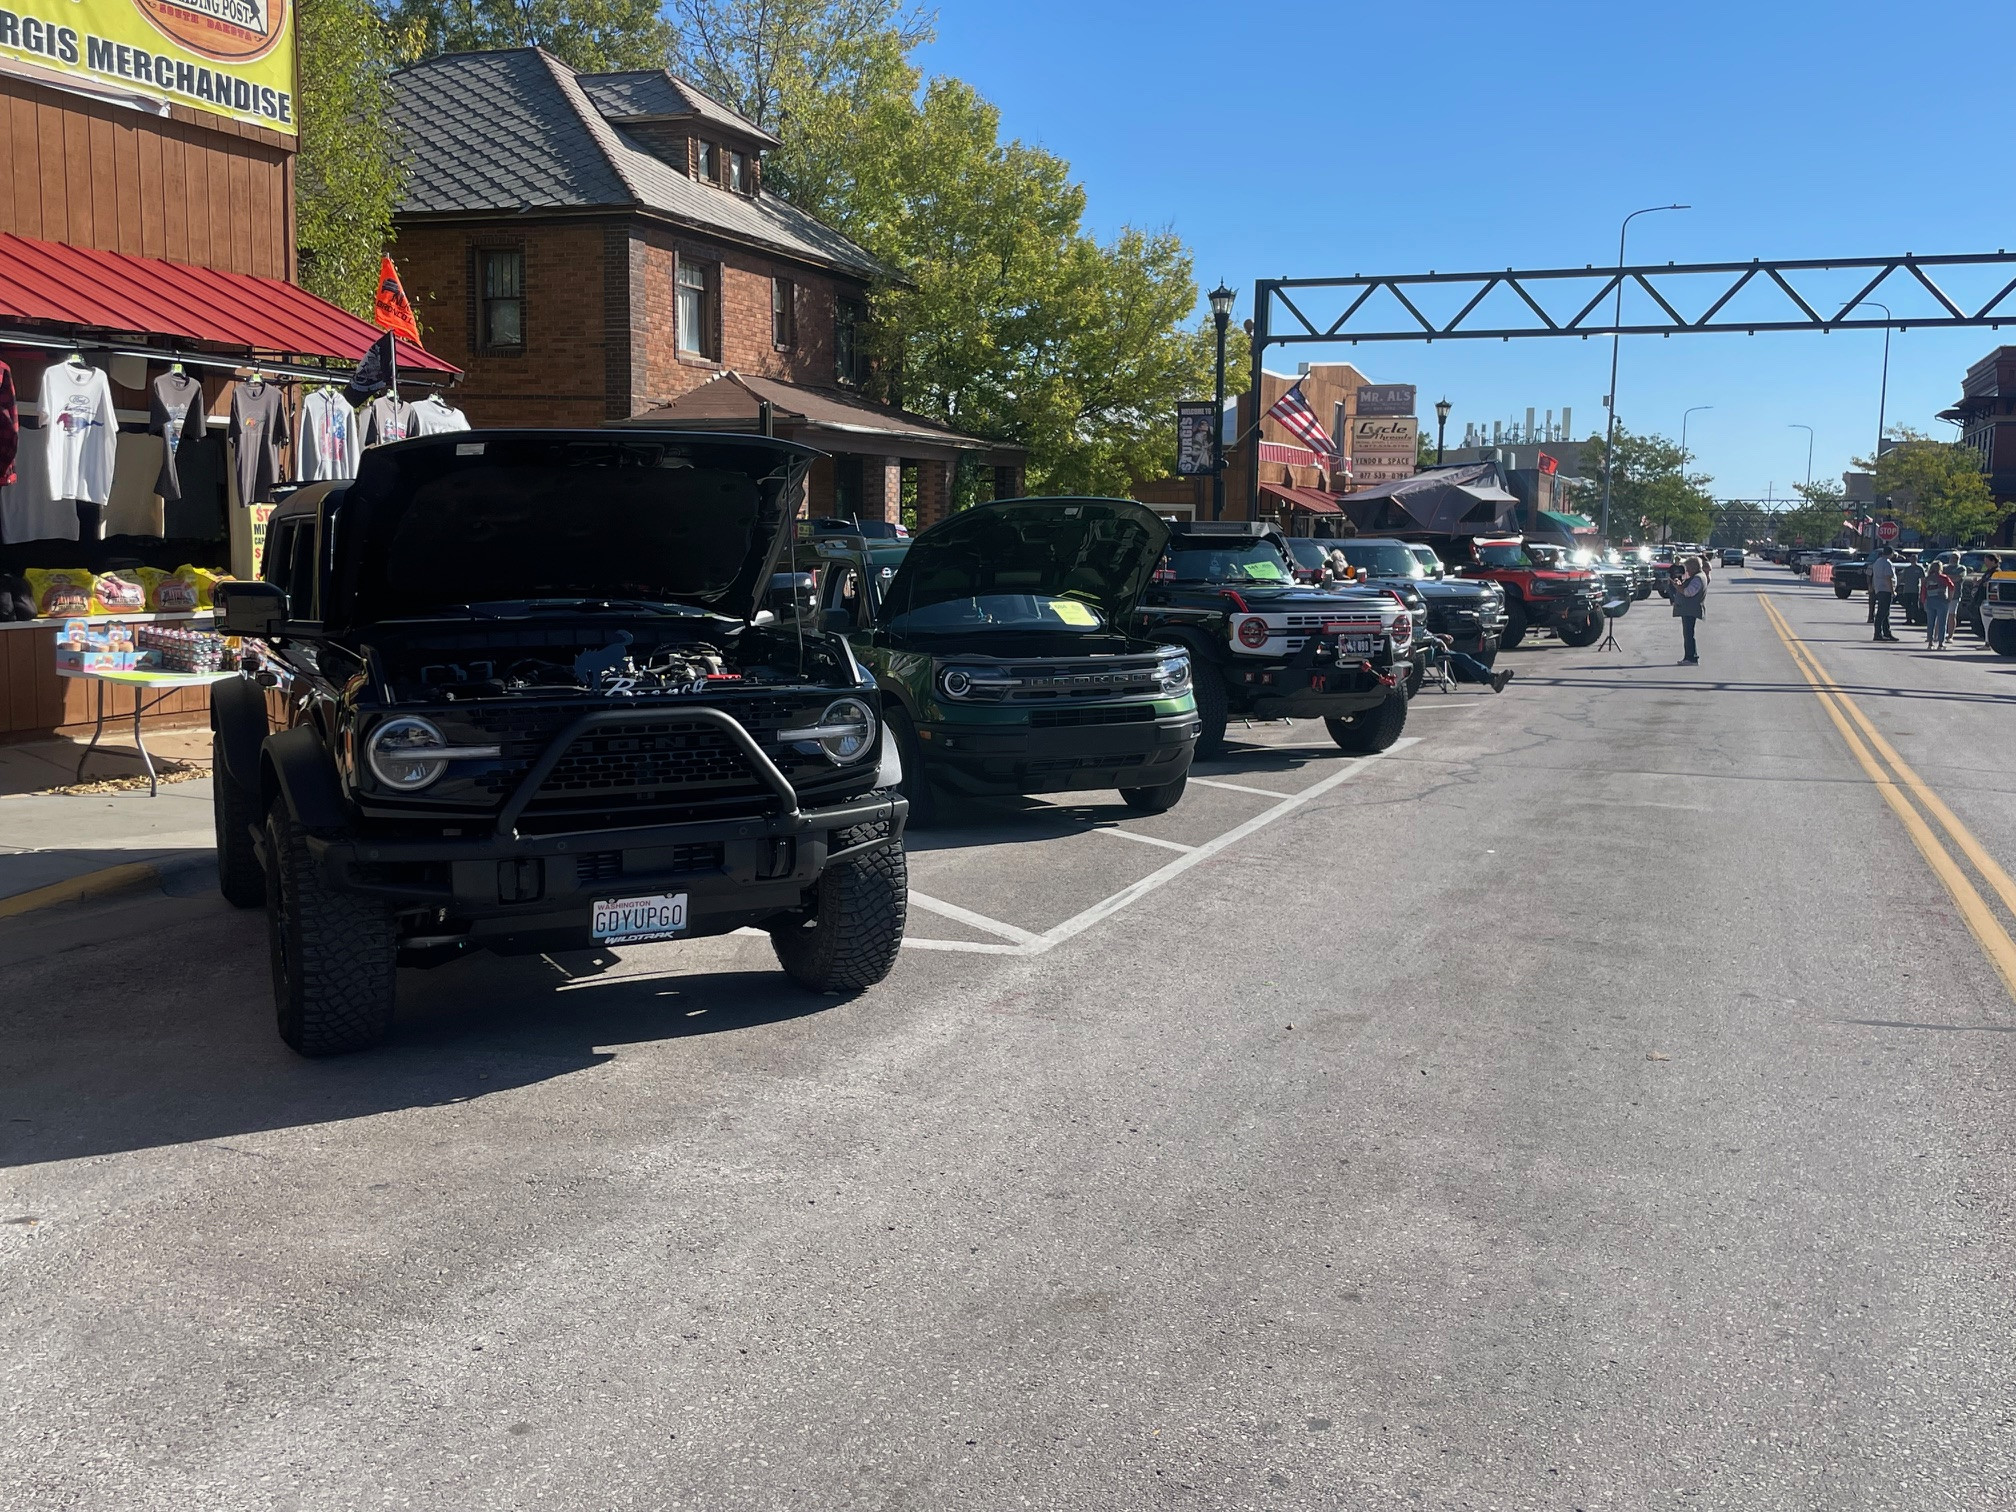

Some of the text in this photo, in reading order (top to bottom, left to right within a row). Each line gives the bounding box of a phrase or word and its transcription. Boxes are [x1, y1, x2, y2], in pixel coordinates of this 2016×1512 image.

[222, 0, 250, 24] POST
[160, 4, 199, 24] SOUTH
[206, 18, 252, 41] DAKOTA
[87, 36, 291, 124] MERCHANDISE
[1360, 390, 1411, 402] MR. AL'S
[1359, 422, 1408, 437] Cycle
[1181, 417, 1193, 471] STURGIS
[1355, 457, 1410, 465] VENDOR SPACE
[597, 900, 651, 911] WASHINGTON
[596, 904, 682, 933] GDYUPGO
[604, 930, 675, 945] WILDTRAK
